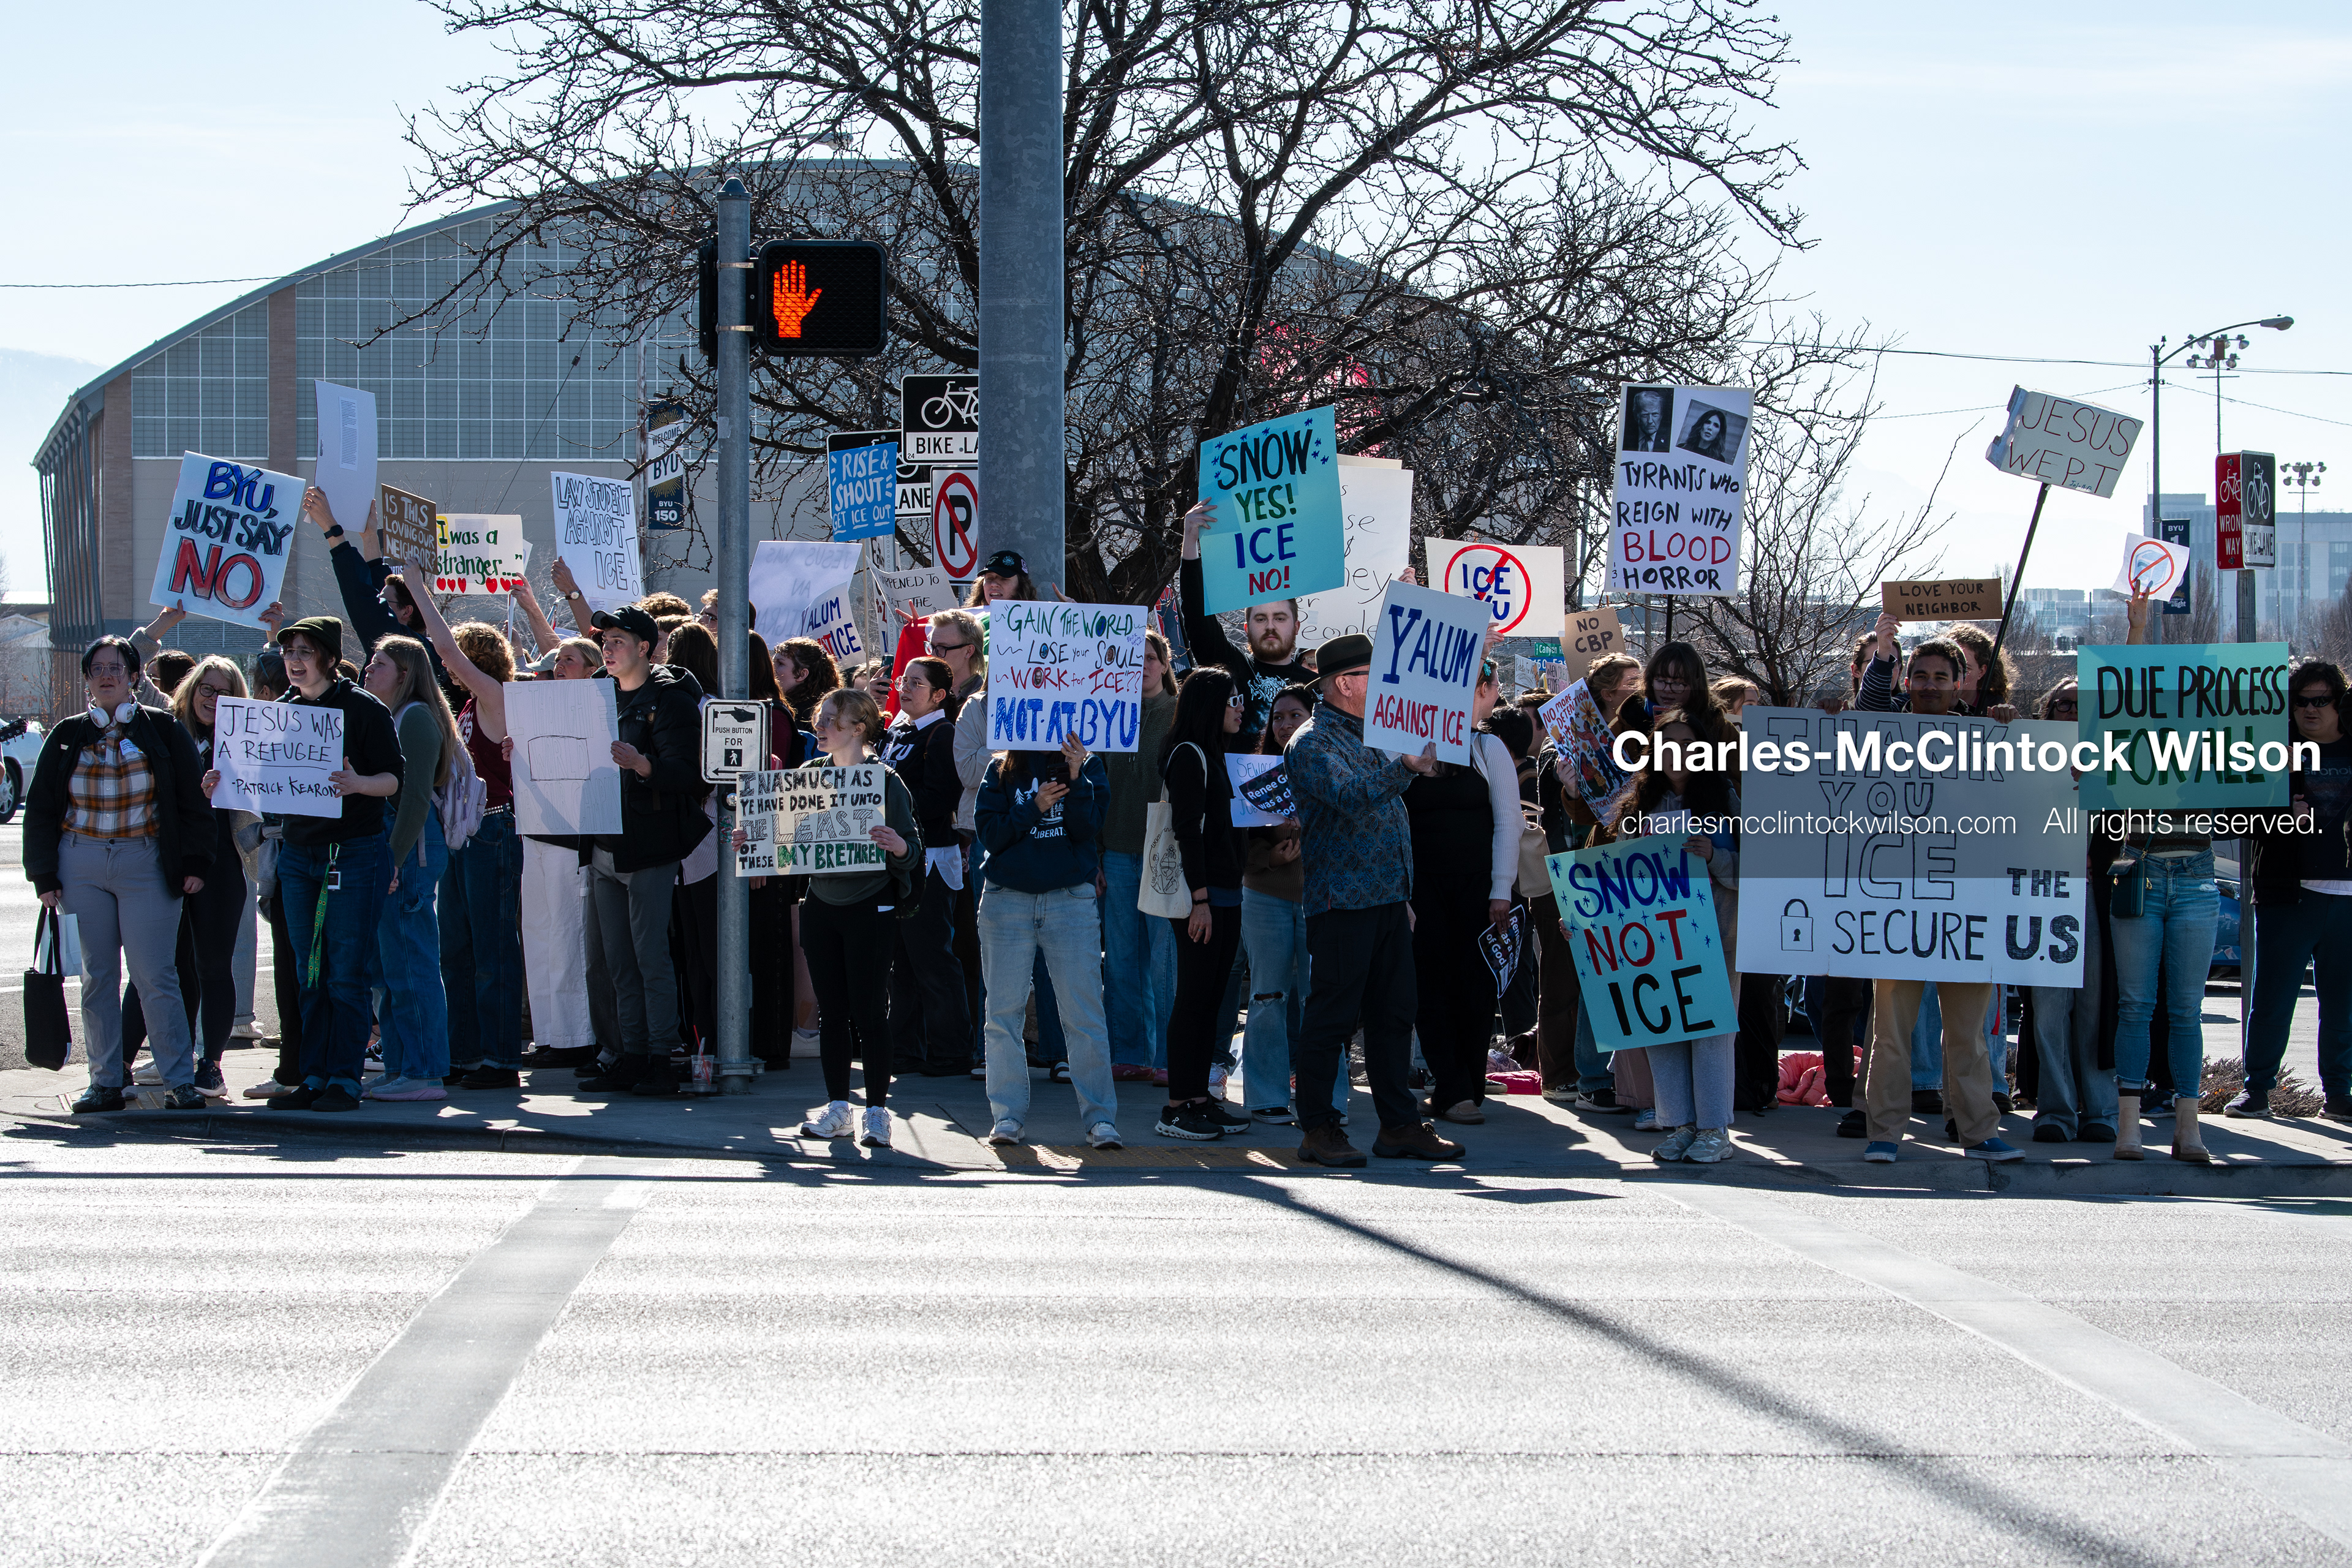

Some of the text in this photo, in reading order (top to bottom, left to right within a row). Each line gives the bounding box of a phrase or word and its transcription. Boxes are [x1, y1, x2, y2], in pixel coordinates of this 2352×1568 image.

[652, 426, 680, 446] WELCOME
[2022, 396, 2136, 456] JESUS
[916, 437, 954, 454] BIKE
[1217, 429, 1313, 491] SNOW
[654, 455, 678, 480] BYU
[842, 449, 889, 481] RISE &
[1621, 461, 1740, 494] TYRANTS WHO
[2009, 442, 2118, 494] WEPT
[203, 462, 279, 519] BYU,
[556, 477, 631, 516] LAW STUDENT
[835, 477, 884, 511] SHOUT
[895, 488, 930, 509] ANE
[1234, 483, 1297, 522] YES!
[385, 492, 428, 527] IS THIS
[655, 510, 678, 521] 150
[832, 504, 891, 531] GET ICE OUT
[1616, 501, 1732, 532] REIGN WITH
[2220, 514, 2241, 532] WRON
[175, 499, 293, 556] JUST SAY
[418, 530, 435, 549] OUR
[435, 521, 498, 545] I was a
[565, 509, 625, 548] AGAINST
[1234, 522, 1297, 568] ICE
[1624, 529, 1731, 565] BLOOD
[2225, 537, 2241, 555] WAY
[2245, 532, 2274, 556] BIKE LANE
[168, 535, 265, 610] NO
[926, 573, 940, 586] TO
[1249, 565, 1291, 596] NO!
[1463, 564, 1510, 595] ICE
[1623, 565, 1722, 591] HORROR
[1899, 583, 1984, 598] LOVE YOUR
[1060, 608, 1080, 638] THE
[1082, 610, 1133, 639] WORLD
[1905, 601, 1981, 616] NEIGHBOR
[1577, 617, 1599, 633] NO
[830, 623, 862, 659] ICE
[1027, 640, 1069, 665] LOSE
[1072, 646, 1090, 662] your
[1095, 640, 1142, 669] SOUL
[1382, 604, 1478, 688] YALUM
[1539, 645, 1558, 655] Canyon
[1575, 631, 1613, 653] CBP
[1011, 666, 1069, 690] WORK
[1071, 673, 1085, 687] for
[2097, 665, 2287, 719] DUE PROCESS
[222, 705, 342, 743] JESUS WAS
[1373, 693, 1465, 746] AGAINST ICE
[1543, 708, 1556, 729] NO
[1555, 693, 1572, 712] MORE
[1556, 691, 1589, 729] DETENTION
[219, 740, 332, 762] A REFUGEE
[880, 743, 914, 760] BYU
[1768, 717, 2009, 782] THANK
[2106, 726, 2266, 786] FOR ALL
[289, 776, 337, 797] KEARON
[739, 768, 873, 797] INASMUCH AS
[1247, 782, 1278, 800] Renee
[740, 793, 882, 816] YE HAVE DONE IT UNTO
[1258, 799, 1275, 810] was
[1819, 780, 1934, 818] YOU
[739, 818, 768, 839] THE
[771, 809, 874, 843] LEAST
[739, 843, 757, 855] OF
[739, 856, 774, 870] THESE
[777, 842, 886, 870] MY BRETHREN
[1825, 831, 1957, 900] ICE
[1569, 848, 1691, 918] SNOW
[2007, 867, 2070, 899] THE
[1487, 934, 1496, 944] of
[1583, 909, 1687, 976] NOT
[1832, 909, 2079, 964] SECURE U.S
[1608, 964, 1716, 1036] ICE
